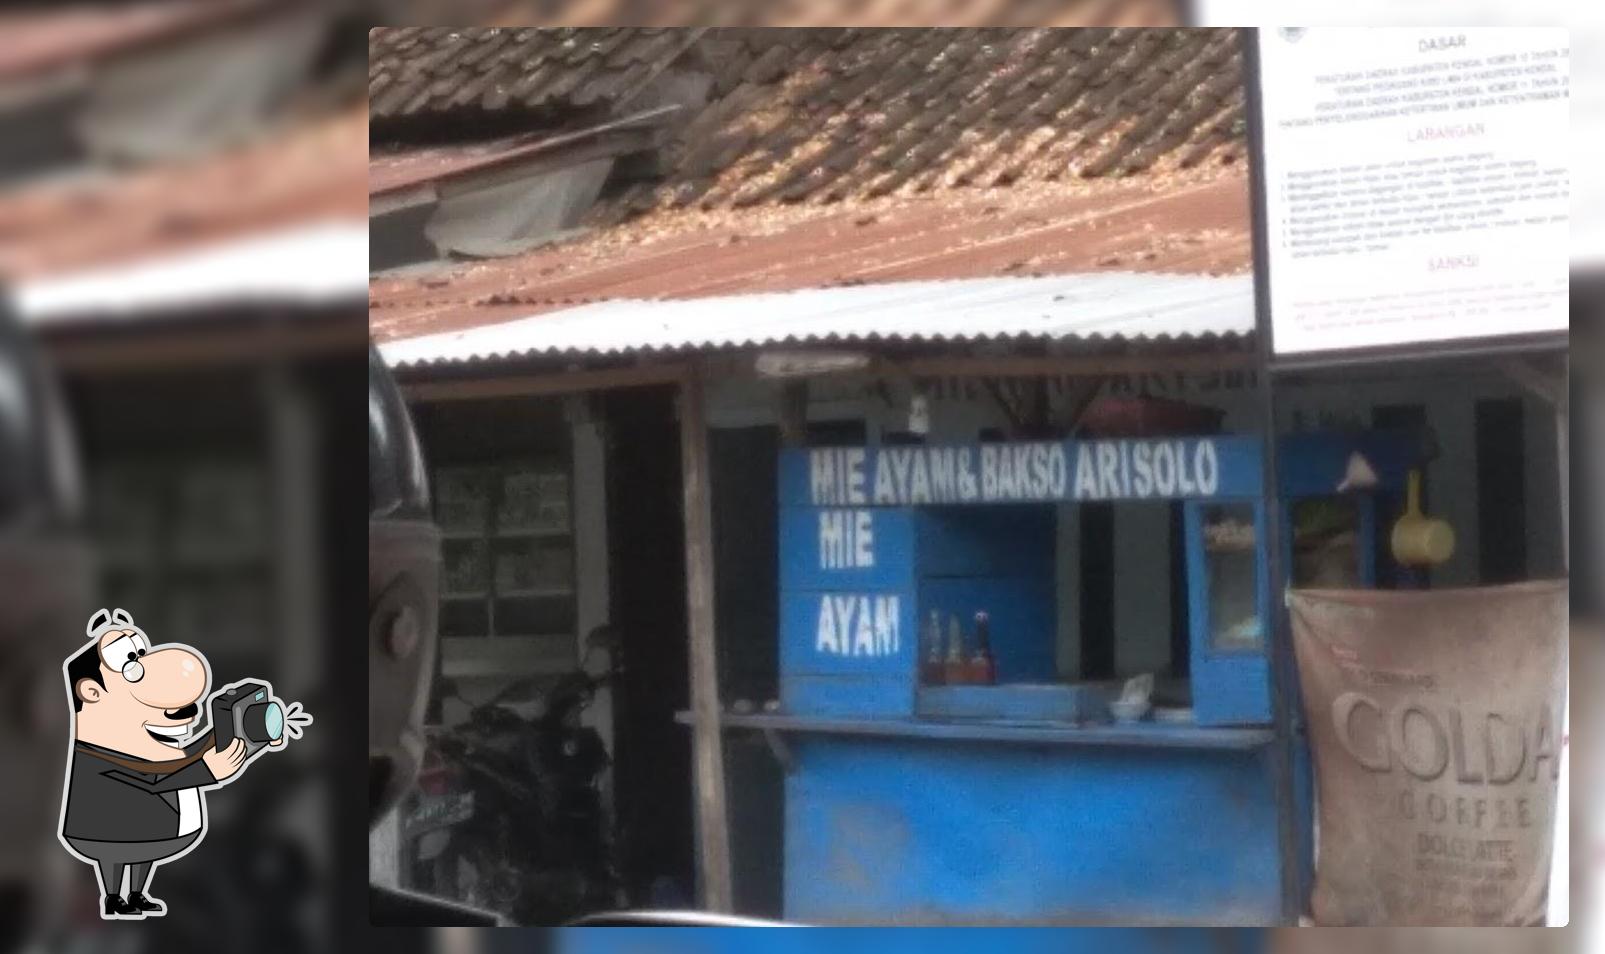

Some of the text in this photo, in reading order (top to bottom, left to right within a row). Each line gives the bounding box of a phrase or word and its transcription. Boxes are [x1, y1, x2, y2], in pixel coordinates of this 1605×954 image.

[1418, 34, 1467, 53] DASAR
[1407, 123, 1485, 143] LARANGAN
[811, 447, 866, 505] MIE
[981, 444, 1065, 498] BAKSO
[819, 511, 875, 569] MIE
[815, 595, 900, 657] AYAM
